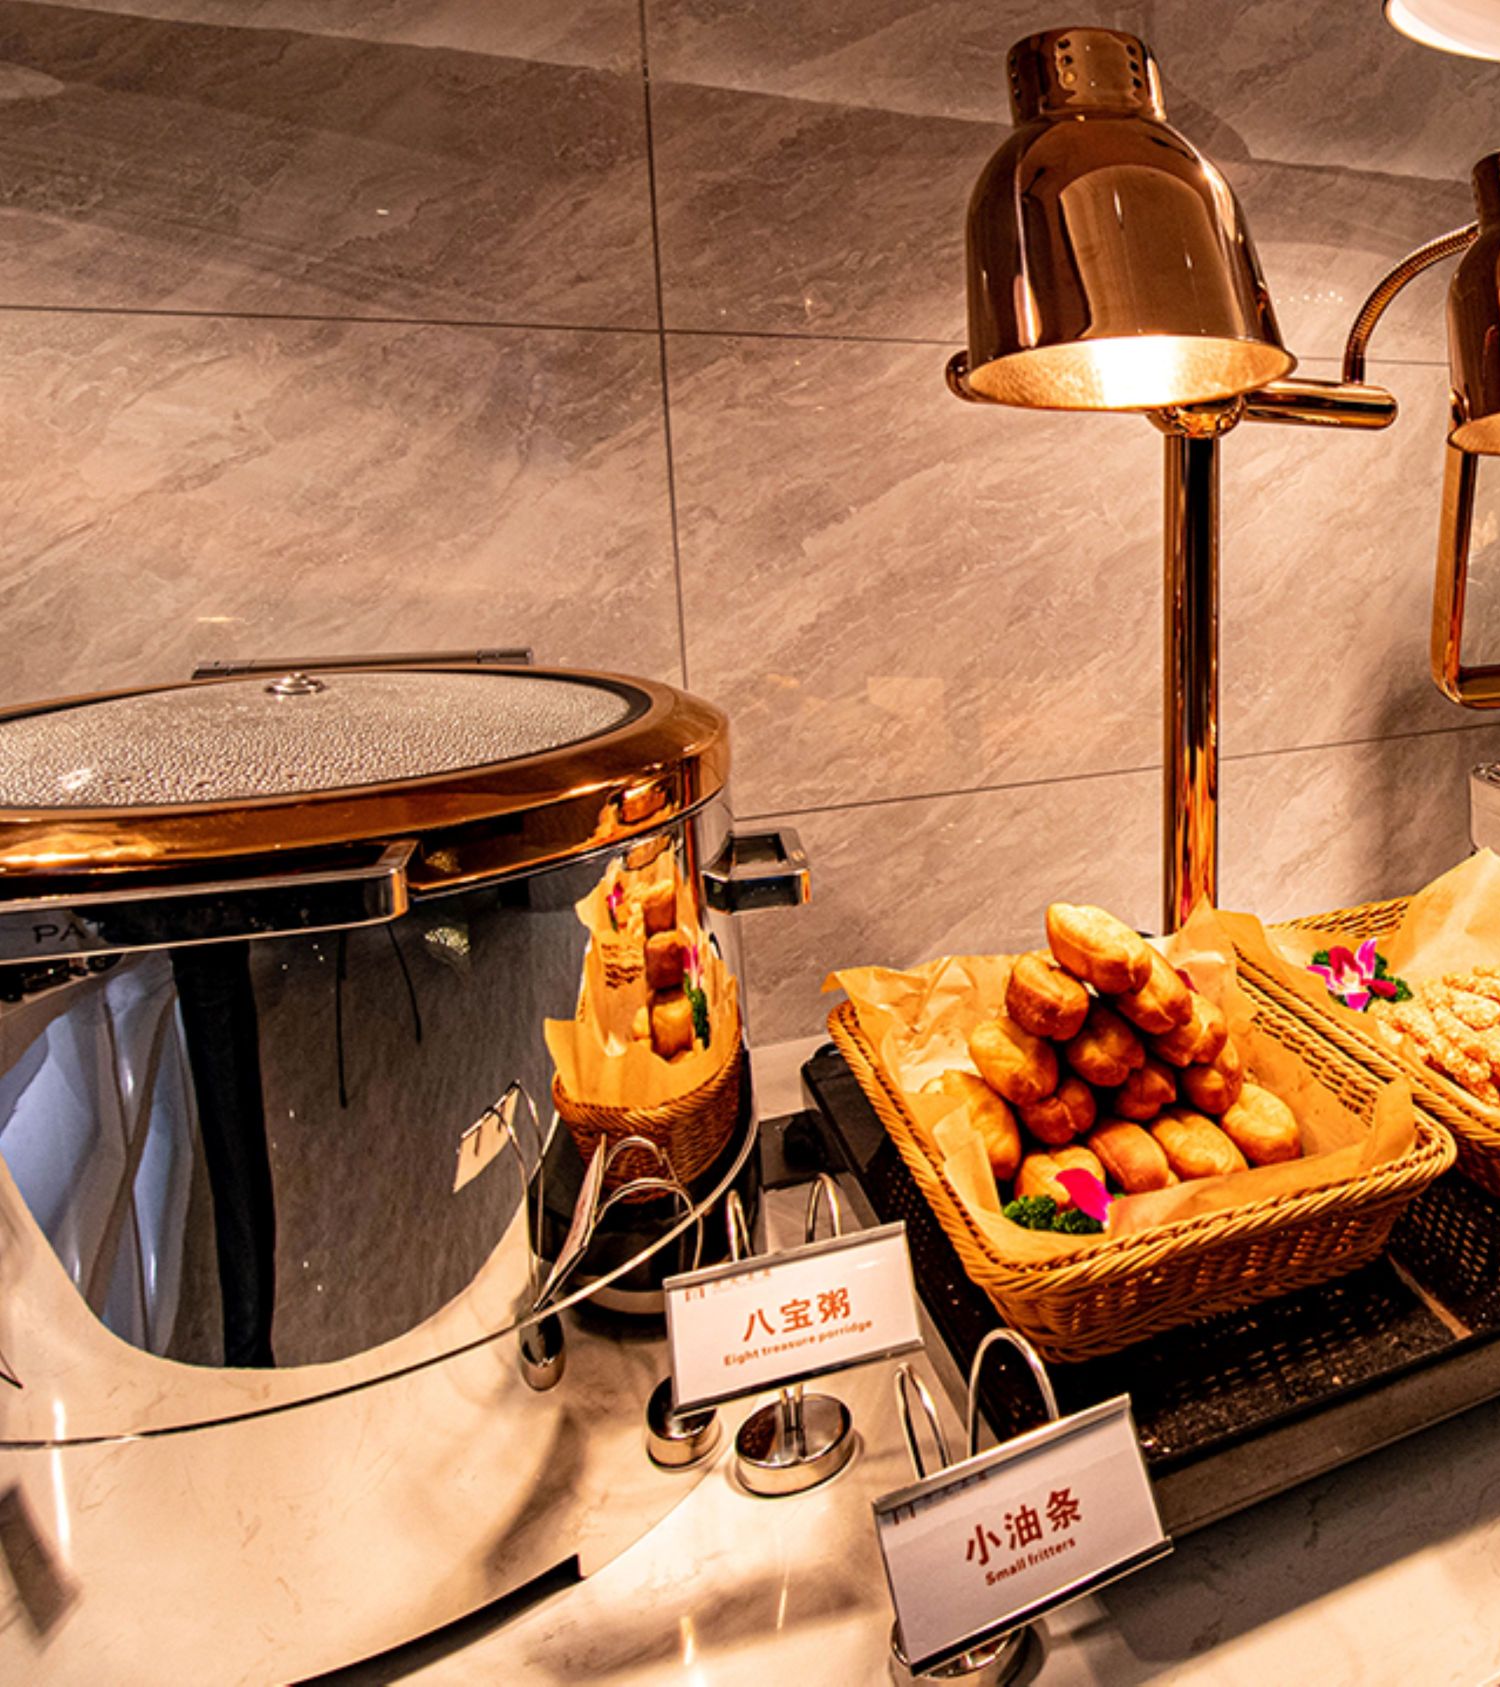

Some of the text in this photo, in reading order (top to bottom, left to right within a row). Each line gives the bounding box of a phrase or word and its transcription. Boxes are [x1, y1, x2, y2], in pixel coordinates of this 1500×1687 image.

[743, 1287, 851, 1342] 八宝粥
[723, 1320, 873, 1366] Eight treasure porridge
[965, 1487, 1083, 1567] 小油条
[985, 1537, 1076, 1586] Small fritters
